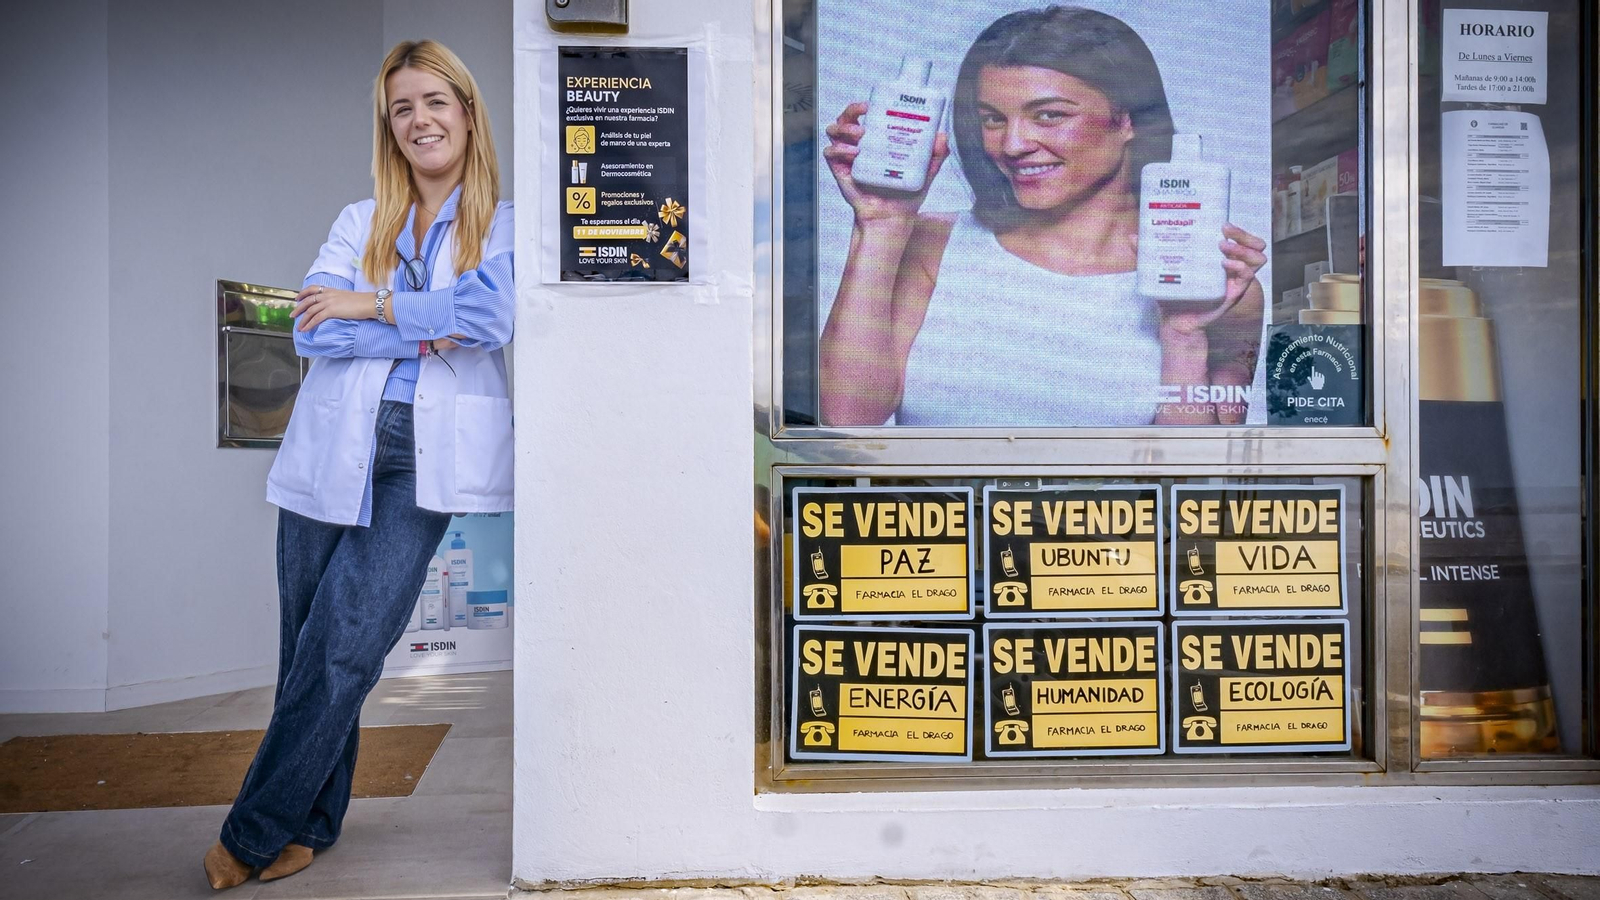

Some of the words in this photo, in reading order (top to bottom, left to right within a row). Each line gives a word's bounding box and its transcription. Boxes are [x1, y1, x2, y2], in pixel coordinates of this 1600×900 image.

[1460, 24, 1534, 37] HORARIO
[1458, 52, 1470, 60] De
[1472, 52, 1495, 60] Lunes
[1504, 53, 1533, 62] Viernes
[566, 76, 652, 89] EXPERIENCIA
[1454, 74, 1483, 82] Mañanas
[566, 91, 620, 102] BEAUTY
[900, 94, 926, 105] ISDIN
[566, 106, 593, 114] ¿Quieres
[620, 107, 656, 115] experiencia
[1160, 179, 1190, 188] ISDIN
[601, 199, 623, 207] regalos
[598, 246, 628, 257] ISDIN
[1273, 334, 1323, 380] Asesoramiento
[1325, 335, 1359, 380] Nutricional
[1290, 362, 1297, 373] en
[1296, 350, 1312, 363] esta
[1312, 348, 1342, 373] Farmacia
[1187, 385, 1252, 403] ISDIN
[1287, 397, 1314, 407] PIDE
[1318, 397, 1345, 407] CITA
[1177, 405, 1215, 414] YOUR
[802, 502, 844, 538] SE
[853, 502, 966, 537] VENDE
[992, 500, 1033, 536] SE
[1041, 500, 1155, 535] VENDE
[1180, 499, 1220, 535] SE
[1229, 499, 1338, 534] VENDE
[1420, 521, 1486, 538] EUTICS
[880, 548, 936, 575] PAZ
[1041, 548, 1130, 566] UBUNTU
[1238, 545, 1316, 571] VIDA
[1431, 565, 1500, 580] INTENSE
[856, 590, 906, 600] FARMACIA
[912, 590, 923, 598] EL
[926, 589, 957, 597] DRAGO
[1048, 587, 1095, 596] FARMACIA
[1101, 586, 1114, 594] EL
[1120, 586, 1147, 594] DRAGO
[1234, 585, 1280, 595] FARMACIA
[1287, 585, 1297, 594] EL
[1301, 584, 1330, 592] DRAGO
[431, 641, 456, 651] ISDIN
[1181, 635, 1223, 670] SE
[1231, 634, 1342, 669] VENDE
[802, 639, 844, 675] SE
[853, 641, 966, 678] VENDE
[993, 638, 1035, 674] SE
[1044, 637, 1156, 673] VENDE
[1037, 687, 1144, 704] HUMANIDAD
[1230, 677, 1334, 702] ECOLOGÍA
[850, 687, 957, 712] ENERGÍA
[1048, 726, 1095, 736] FARMACIA
[1101, 725, 1111, 733] EL
[1237, 722, 1280, 731] FARMACIA
[1288, 722, 1297, 730] EL
[853, 729, 899, 738] FARMACIA
[907, 731, 919, 739] EL
[923, 731, 954, 740] DRAGO
